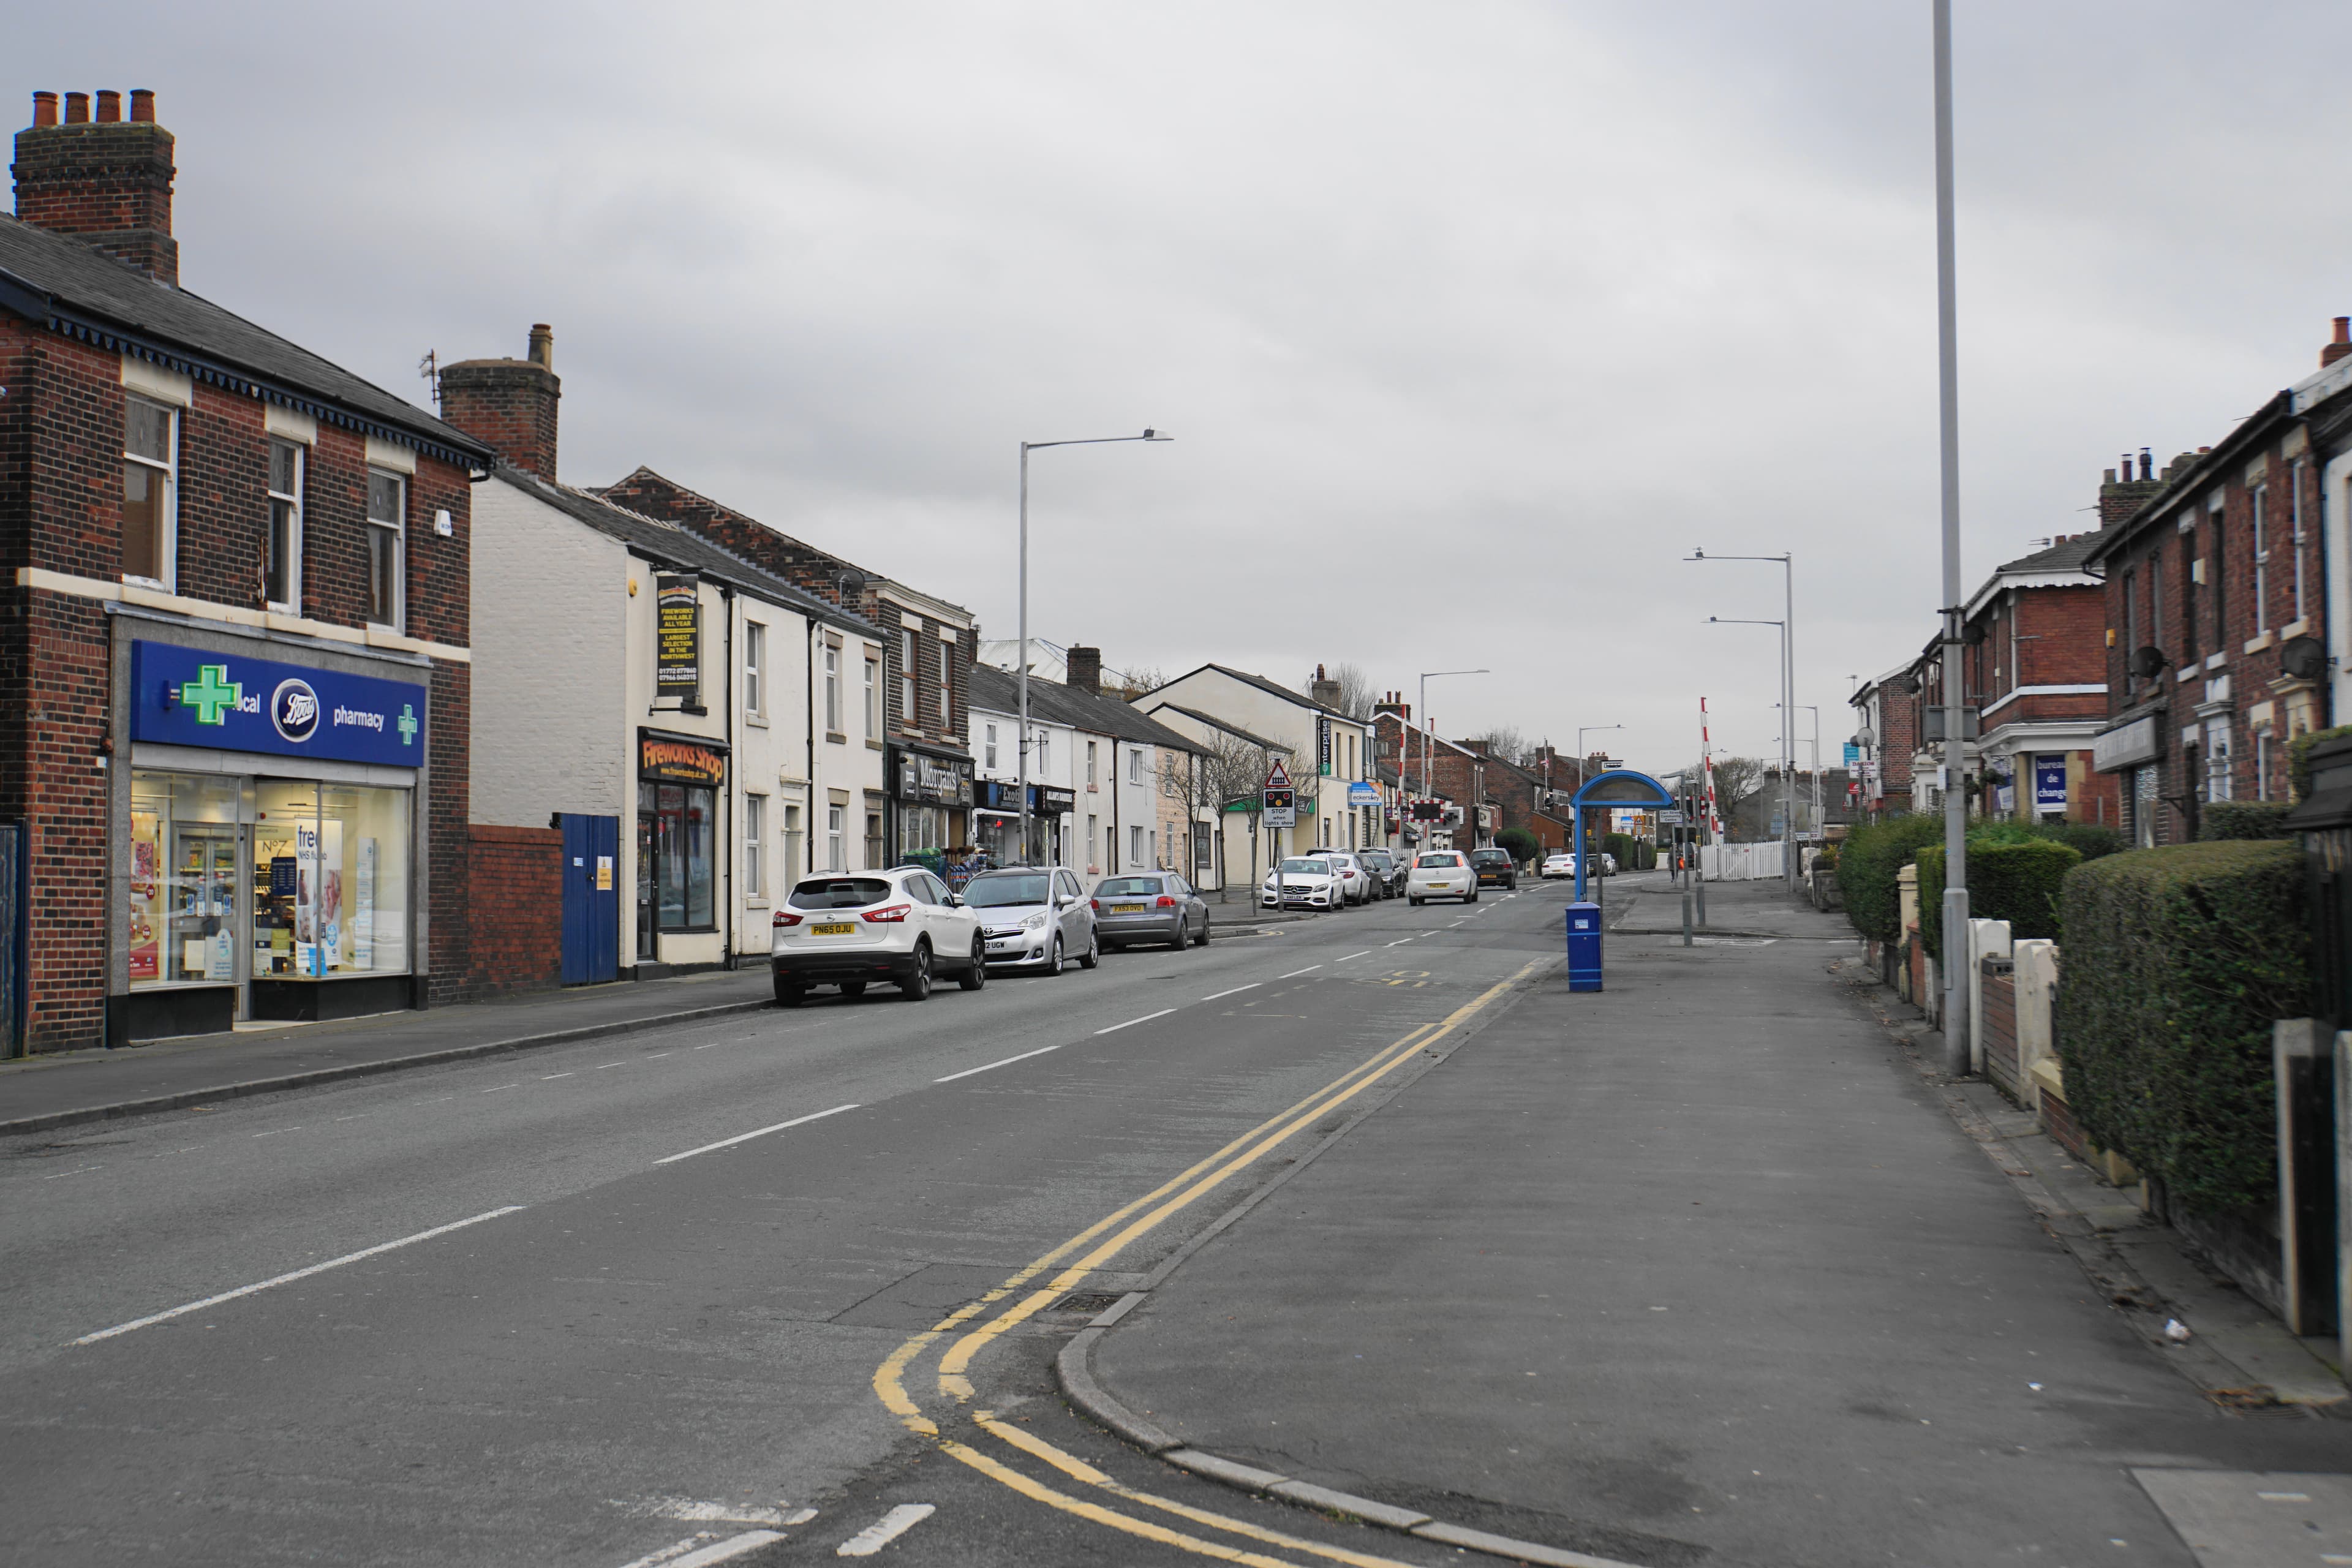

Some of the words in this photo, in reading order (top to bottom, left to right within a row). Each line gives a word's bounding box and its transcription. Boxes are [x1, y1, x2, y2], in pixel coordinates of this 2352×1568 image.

[283, 693, 315, 725] Boots
[334, 704, 384, 732] pharmacy
[2037, 760, 2065, 769] bureau
[920, 759, 956, 797] Morgan's
[2046, 774, 2059, 783] de
[2038, 788, 2068, 799] change
[298, 825, 318, 848] fre
[299, 850, 310, 860] NHS
